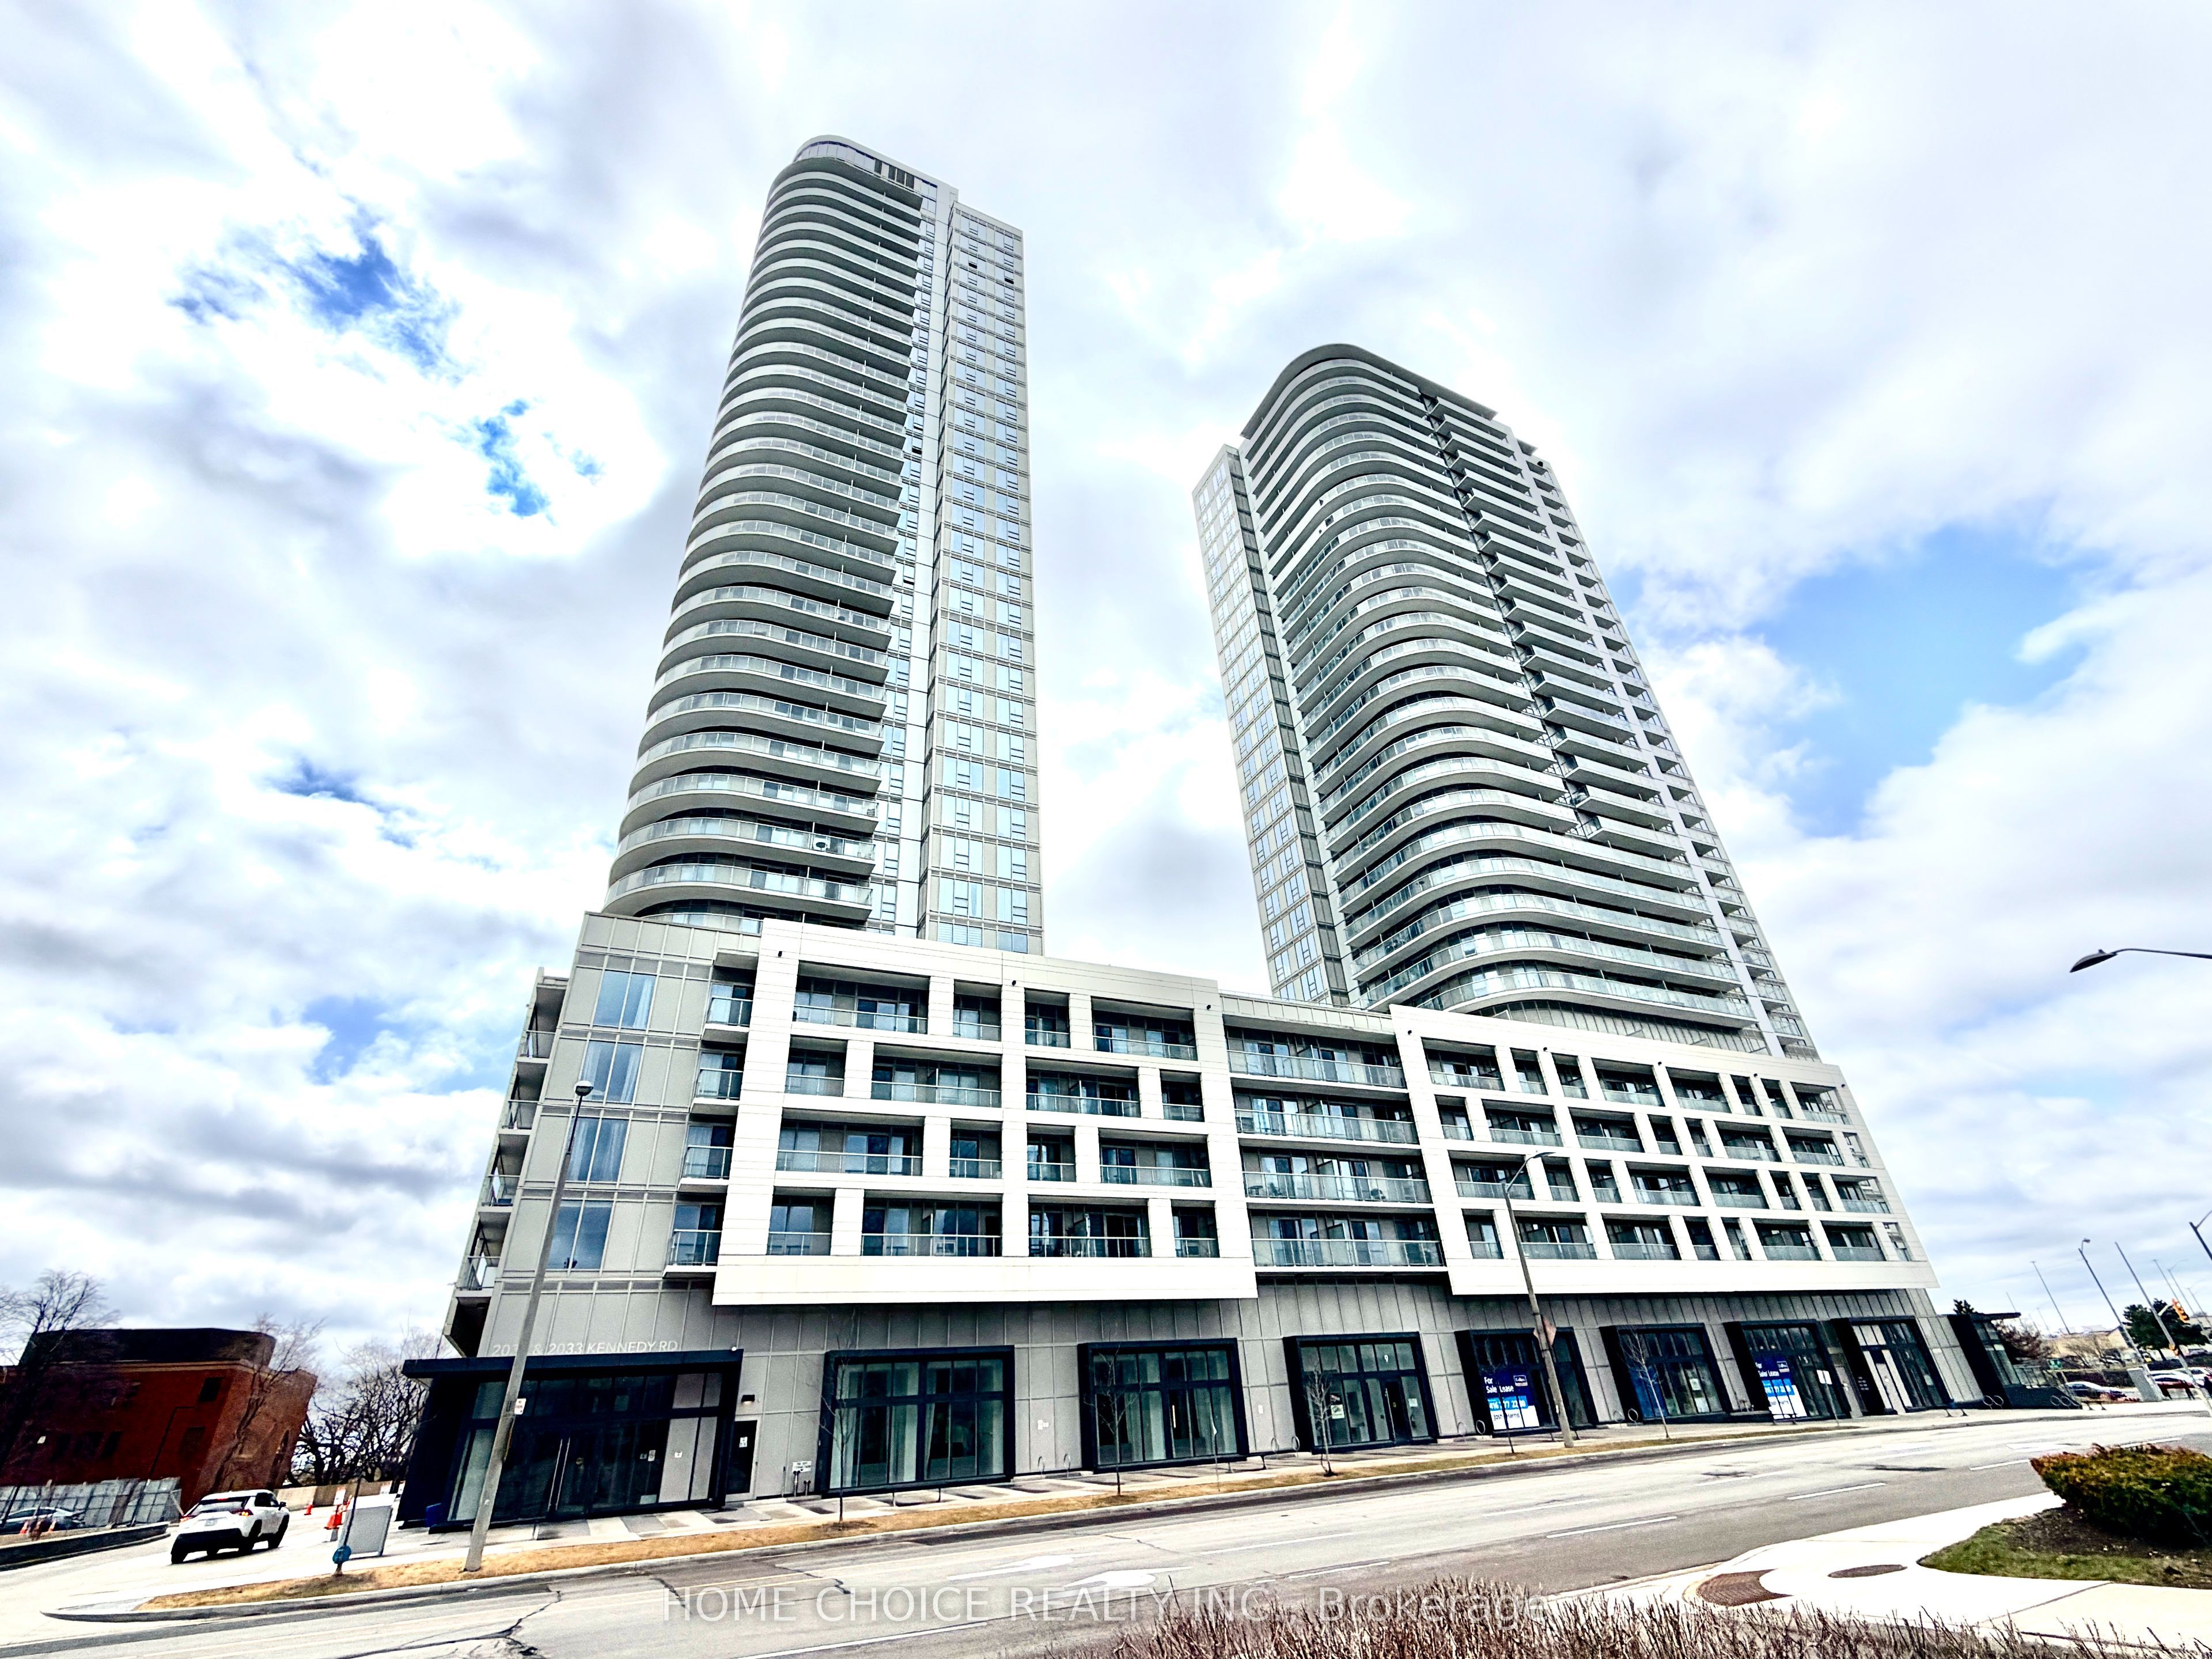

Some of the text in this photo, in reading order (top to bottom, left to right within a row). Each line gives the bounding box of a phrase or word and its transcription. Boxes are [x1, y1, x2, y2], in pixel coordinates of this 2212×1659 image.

[491, 1340, 678, 1355] 20 & 2033 KENNEDY RD
[1484, 1376, 1493, 1384] For
[1499, 1385, 1514, 1393] Lease
